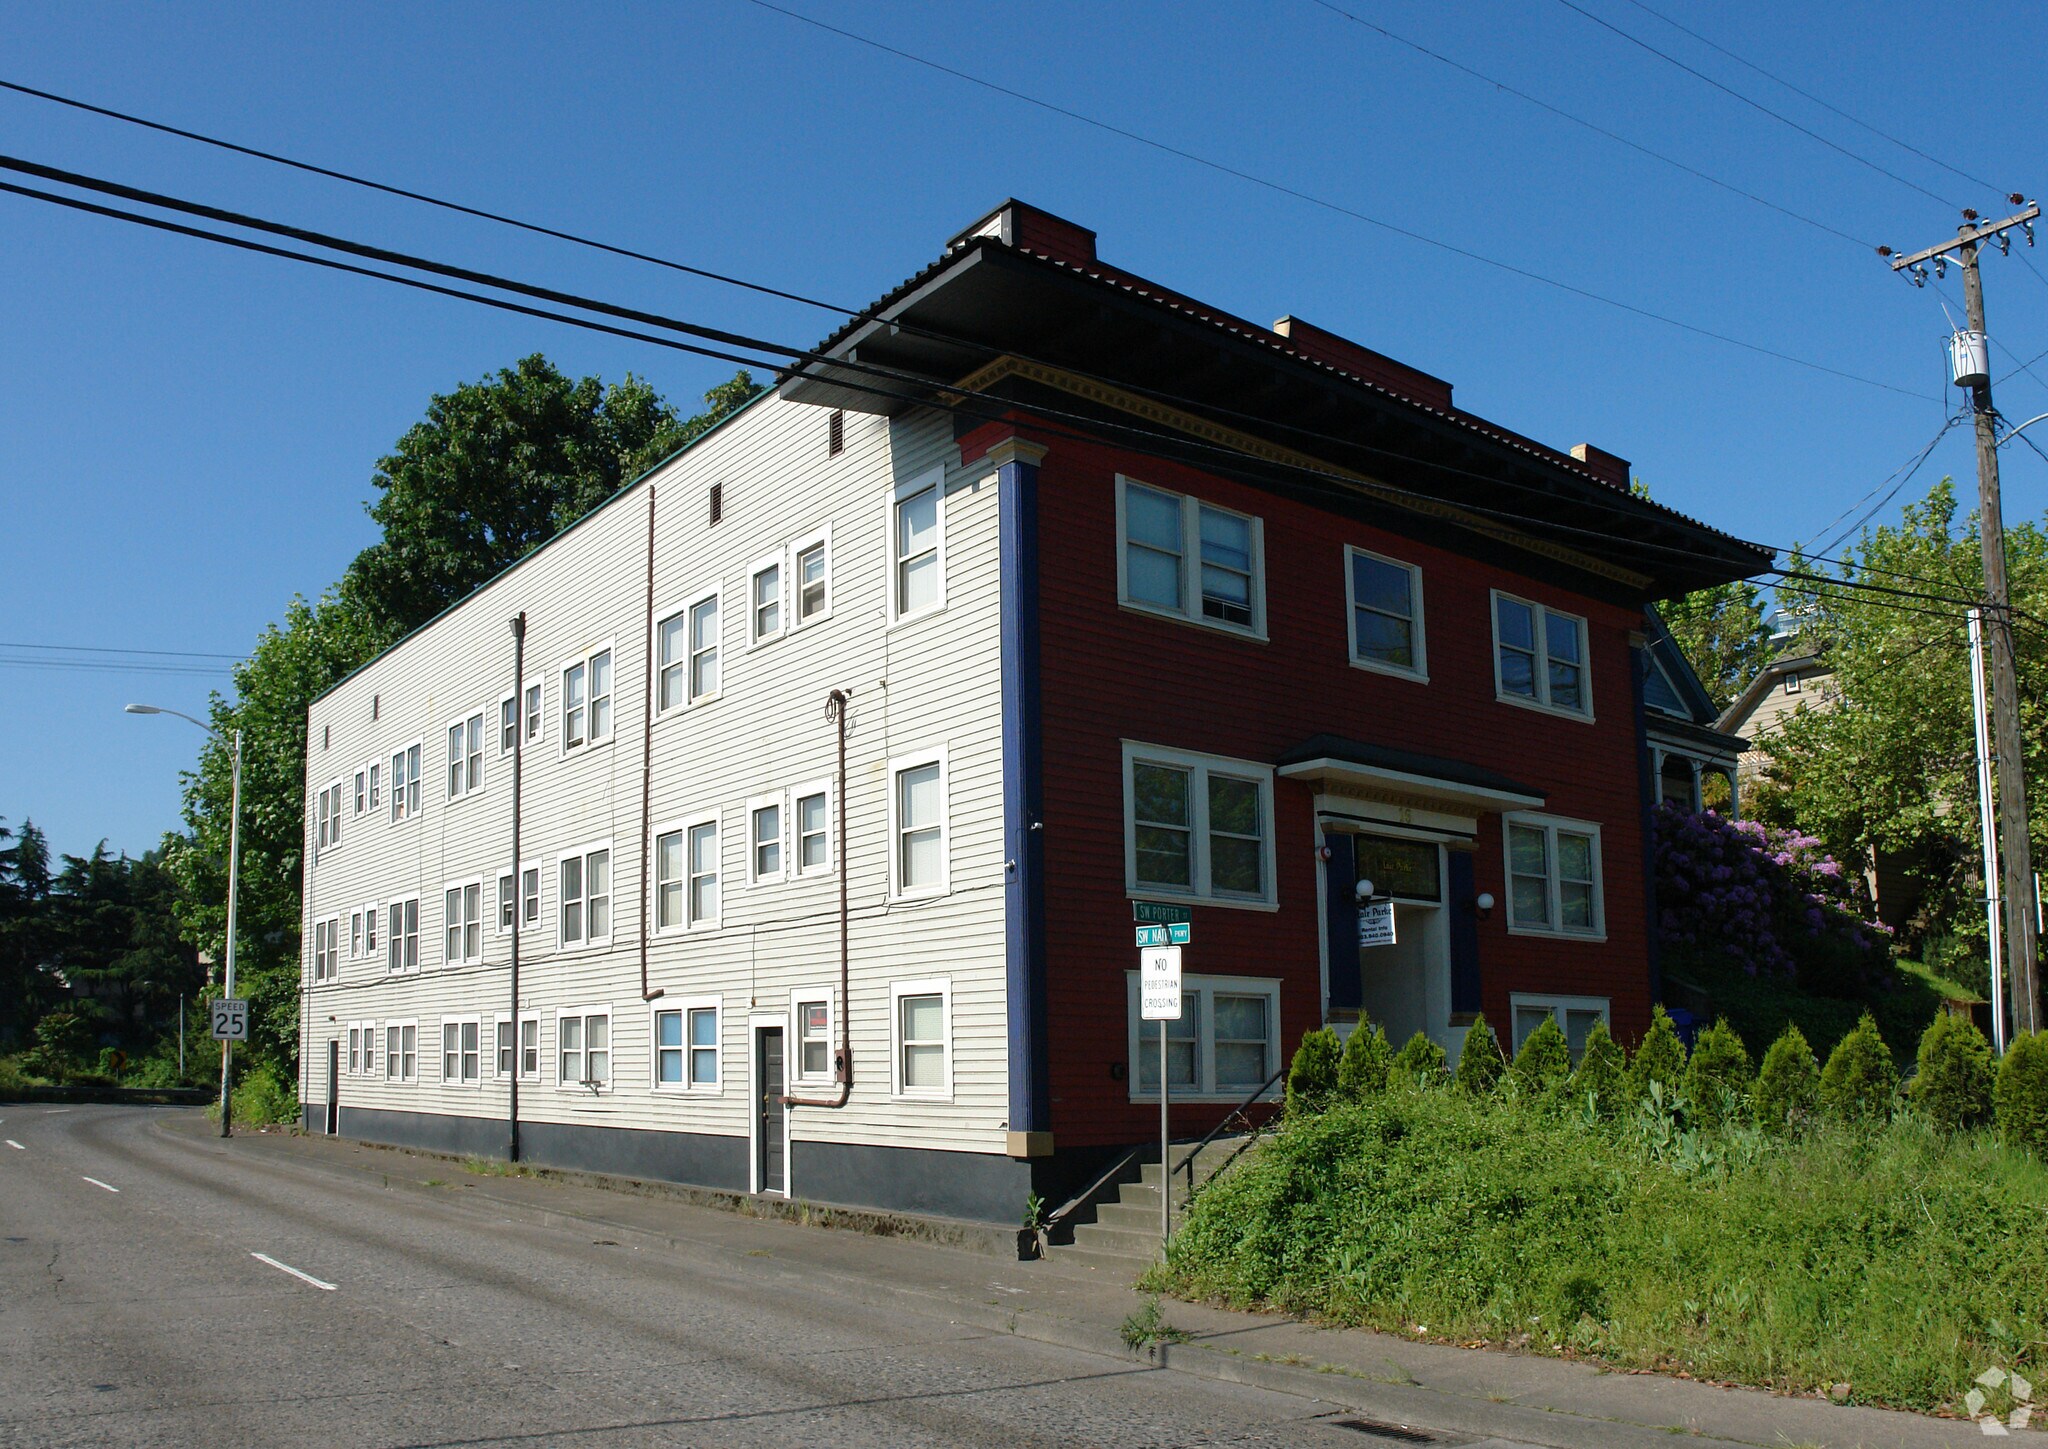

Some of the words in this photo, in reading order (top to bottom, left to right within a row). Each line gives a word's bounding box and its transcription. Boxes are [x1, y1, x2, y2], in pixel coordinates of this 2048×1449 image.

[1140, 905, 1150, 919] SW
[1152, 906, 1180, 921] PORTER
[1138, 930, 1149, 944] SW
[1174, 929, 1187, 938] PKWY
[1155, 958, 1168, 971] NO
[1144, 979, 1178, 990] PEDESTRIAN
[215, 1002, 245, 1011] SPEED
[1144, 997, 1178, 1009] CROSSING
[215, 1012, 244, 1035] 25
